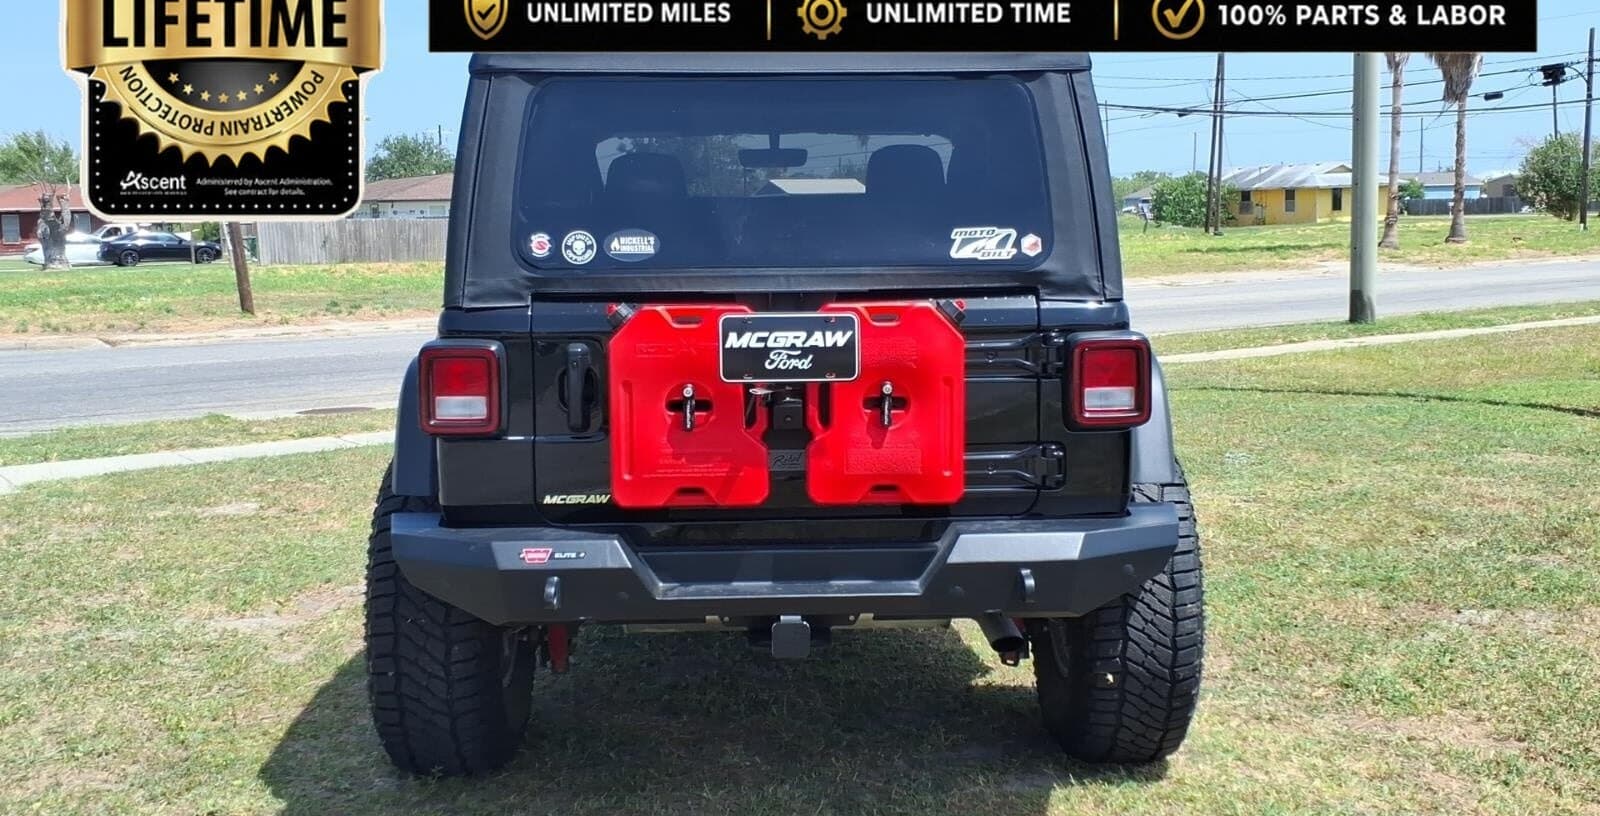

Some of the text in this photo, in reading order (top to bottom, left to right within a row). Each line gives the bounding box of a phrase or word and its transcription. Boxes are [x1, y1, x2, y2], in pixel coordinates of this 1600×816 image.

[724, 330, 853, 349] MCGRAW
[764, 349, 814, 370] Ford
[543, 494, 611, 505] MCGRAW
